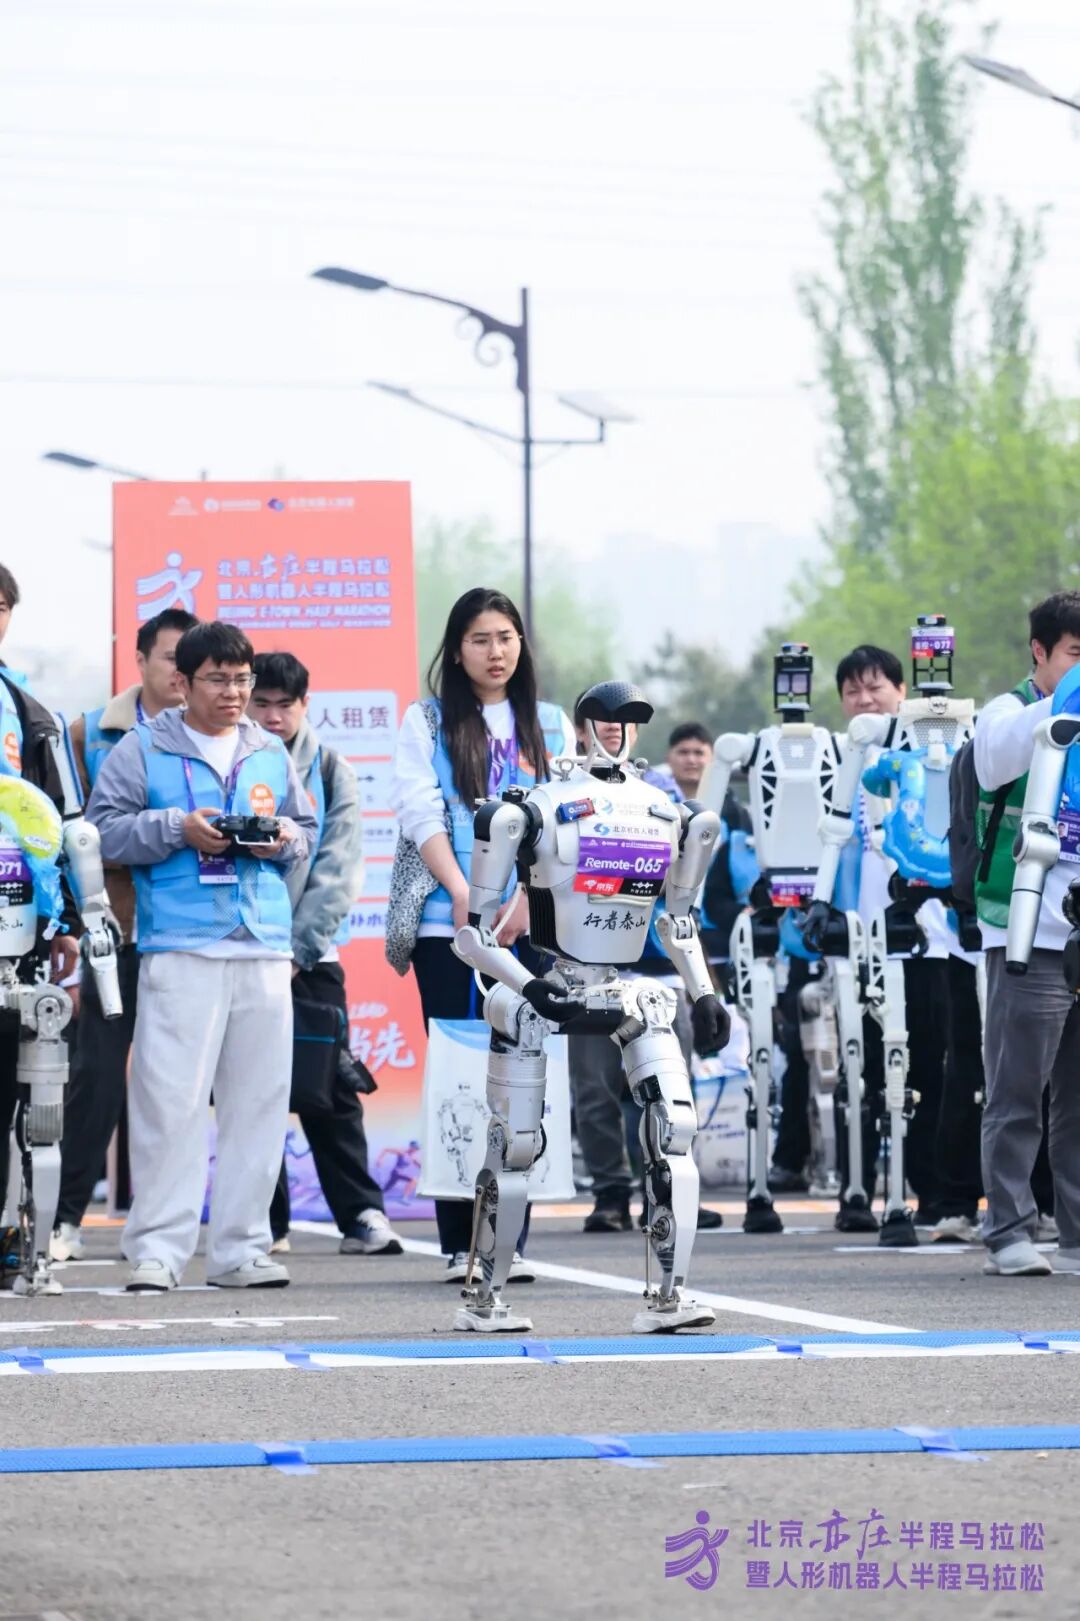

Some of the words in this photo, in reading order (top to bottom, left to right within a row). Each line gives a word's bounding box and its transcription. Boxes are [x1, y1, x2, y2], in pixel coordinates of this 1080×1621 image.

[584, 857, 664, 873] Remote-065
[583, 910, 646, 931] 行者泰山
